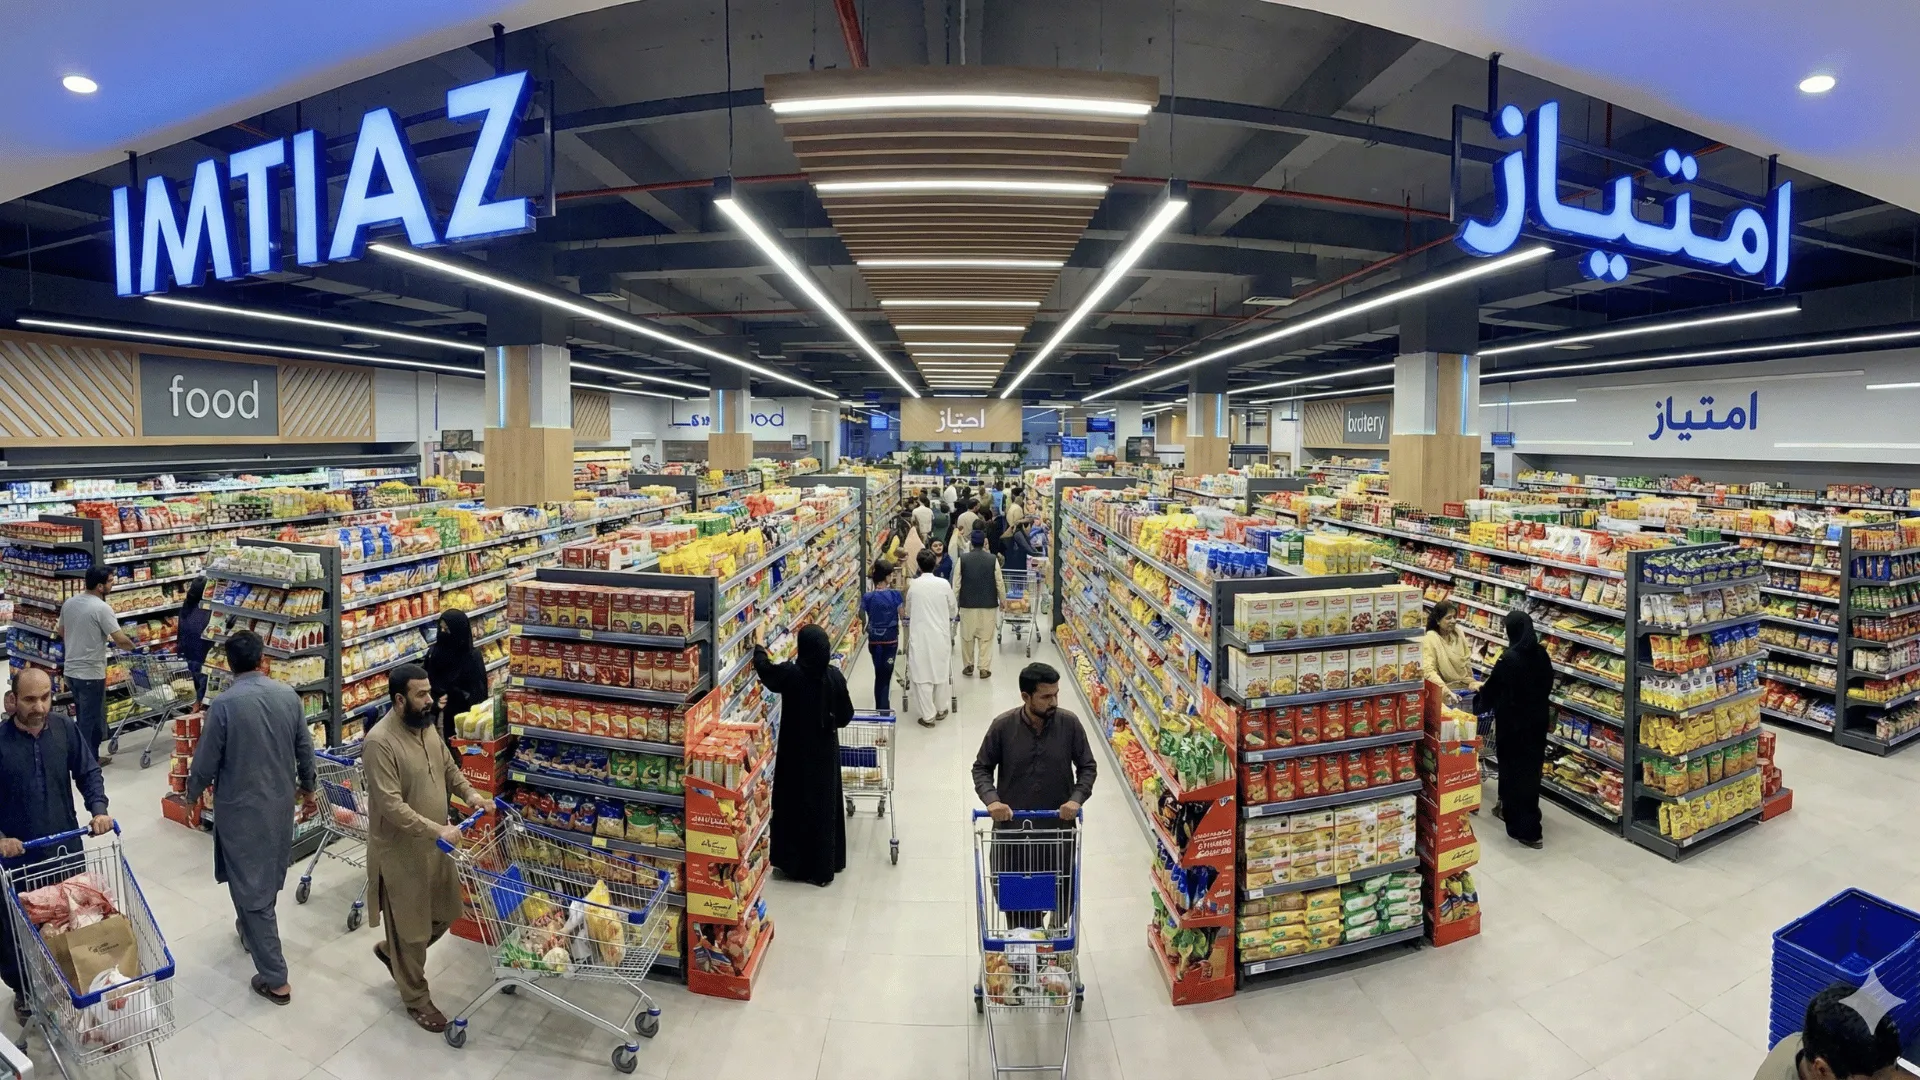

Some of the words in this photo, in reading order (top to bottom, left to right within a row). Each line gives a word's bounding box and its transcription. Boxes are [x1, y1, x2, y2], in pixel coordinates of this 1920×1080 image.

[112, 70, 535, 298] IMTIAZ
[1455, 99, 1792, 289] امتياز
[169, 375, 260, 420] food
[1648, 390, 1758, 441] امتياز
